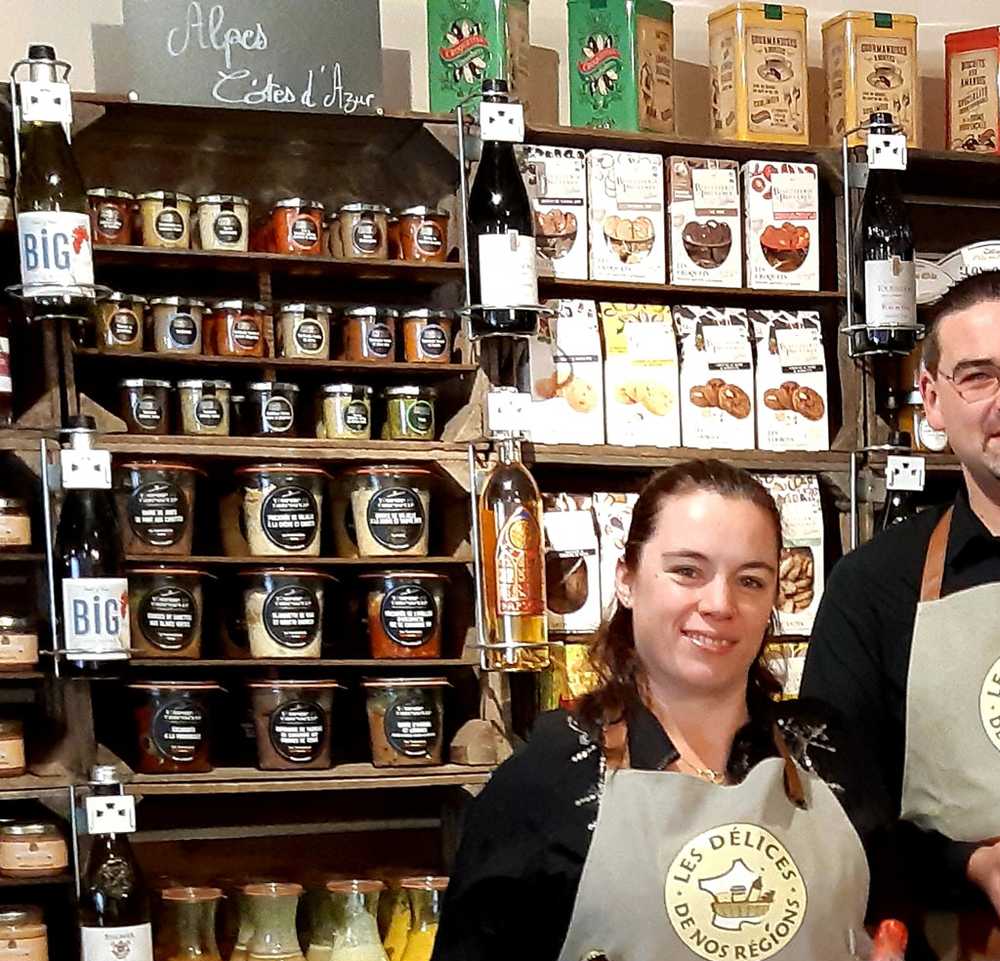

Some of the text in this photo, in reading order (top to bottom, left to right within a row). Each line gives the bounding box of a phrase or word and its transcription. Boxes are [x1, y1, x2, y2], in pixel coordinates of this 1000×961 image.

[168, 1, 268, 69] Alpes
[673, 826, 797, 884] LES DÉLICES
[674, 898, 800, 960] DE NOS RÉGIONS
